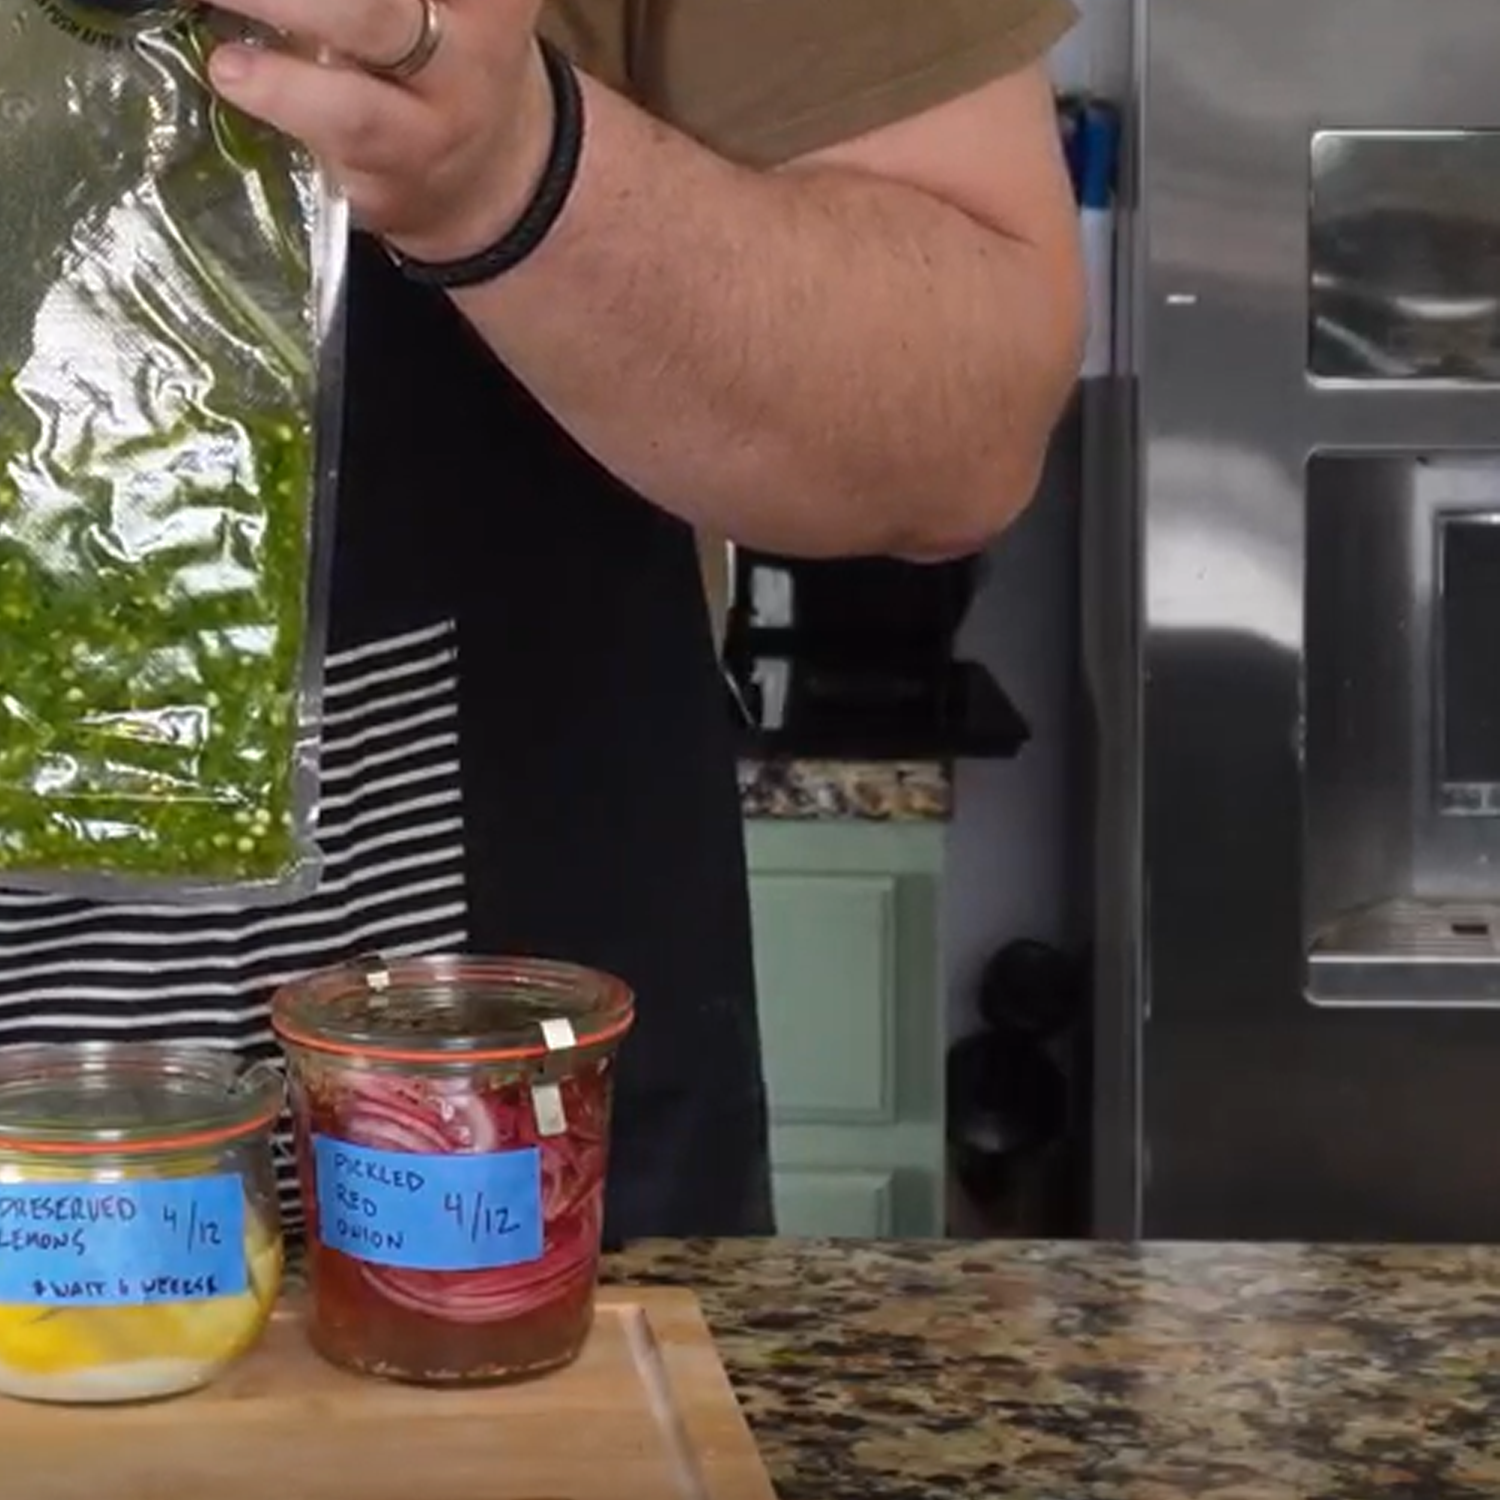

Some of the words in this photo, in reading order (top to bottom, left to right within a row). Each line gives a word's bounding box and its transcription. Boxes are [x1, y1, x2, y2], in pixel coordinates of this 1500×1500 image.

[334, 1153, 426, 1192] PICKLED
[336, 1183, 378, 1217] RED
[444, 1191, 521, 1243] 4/12
[163, 1200, 222, 1254] 4/12
[337, 1219, 405, 1250] ONION
